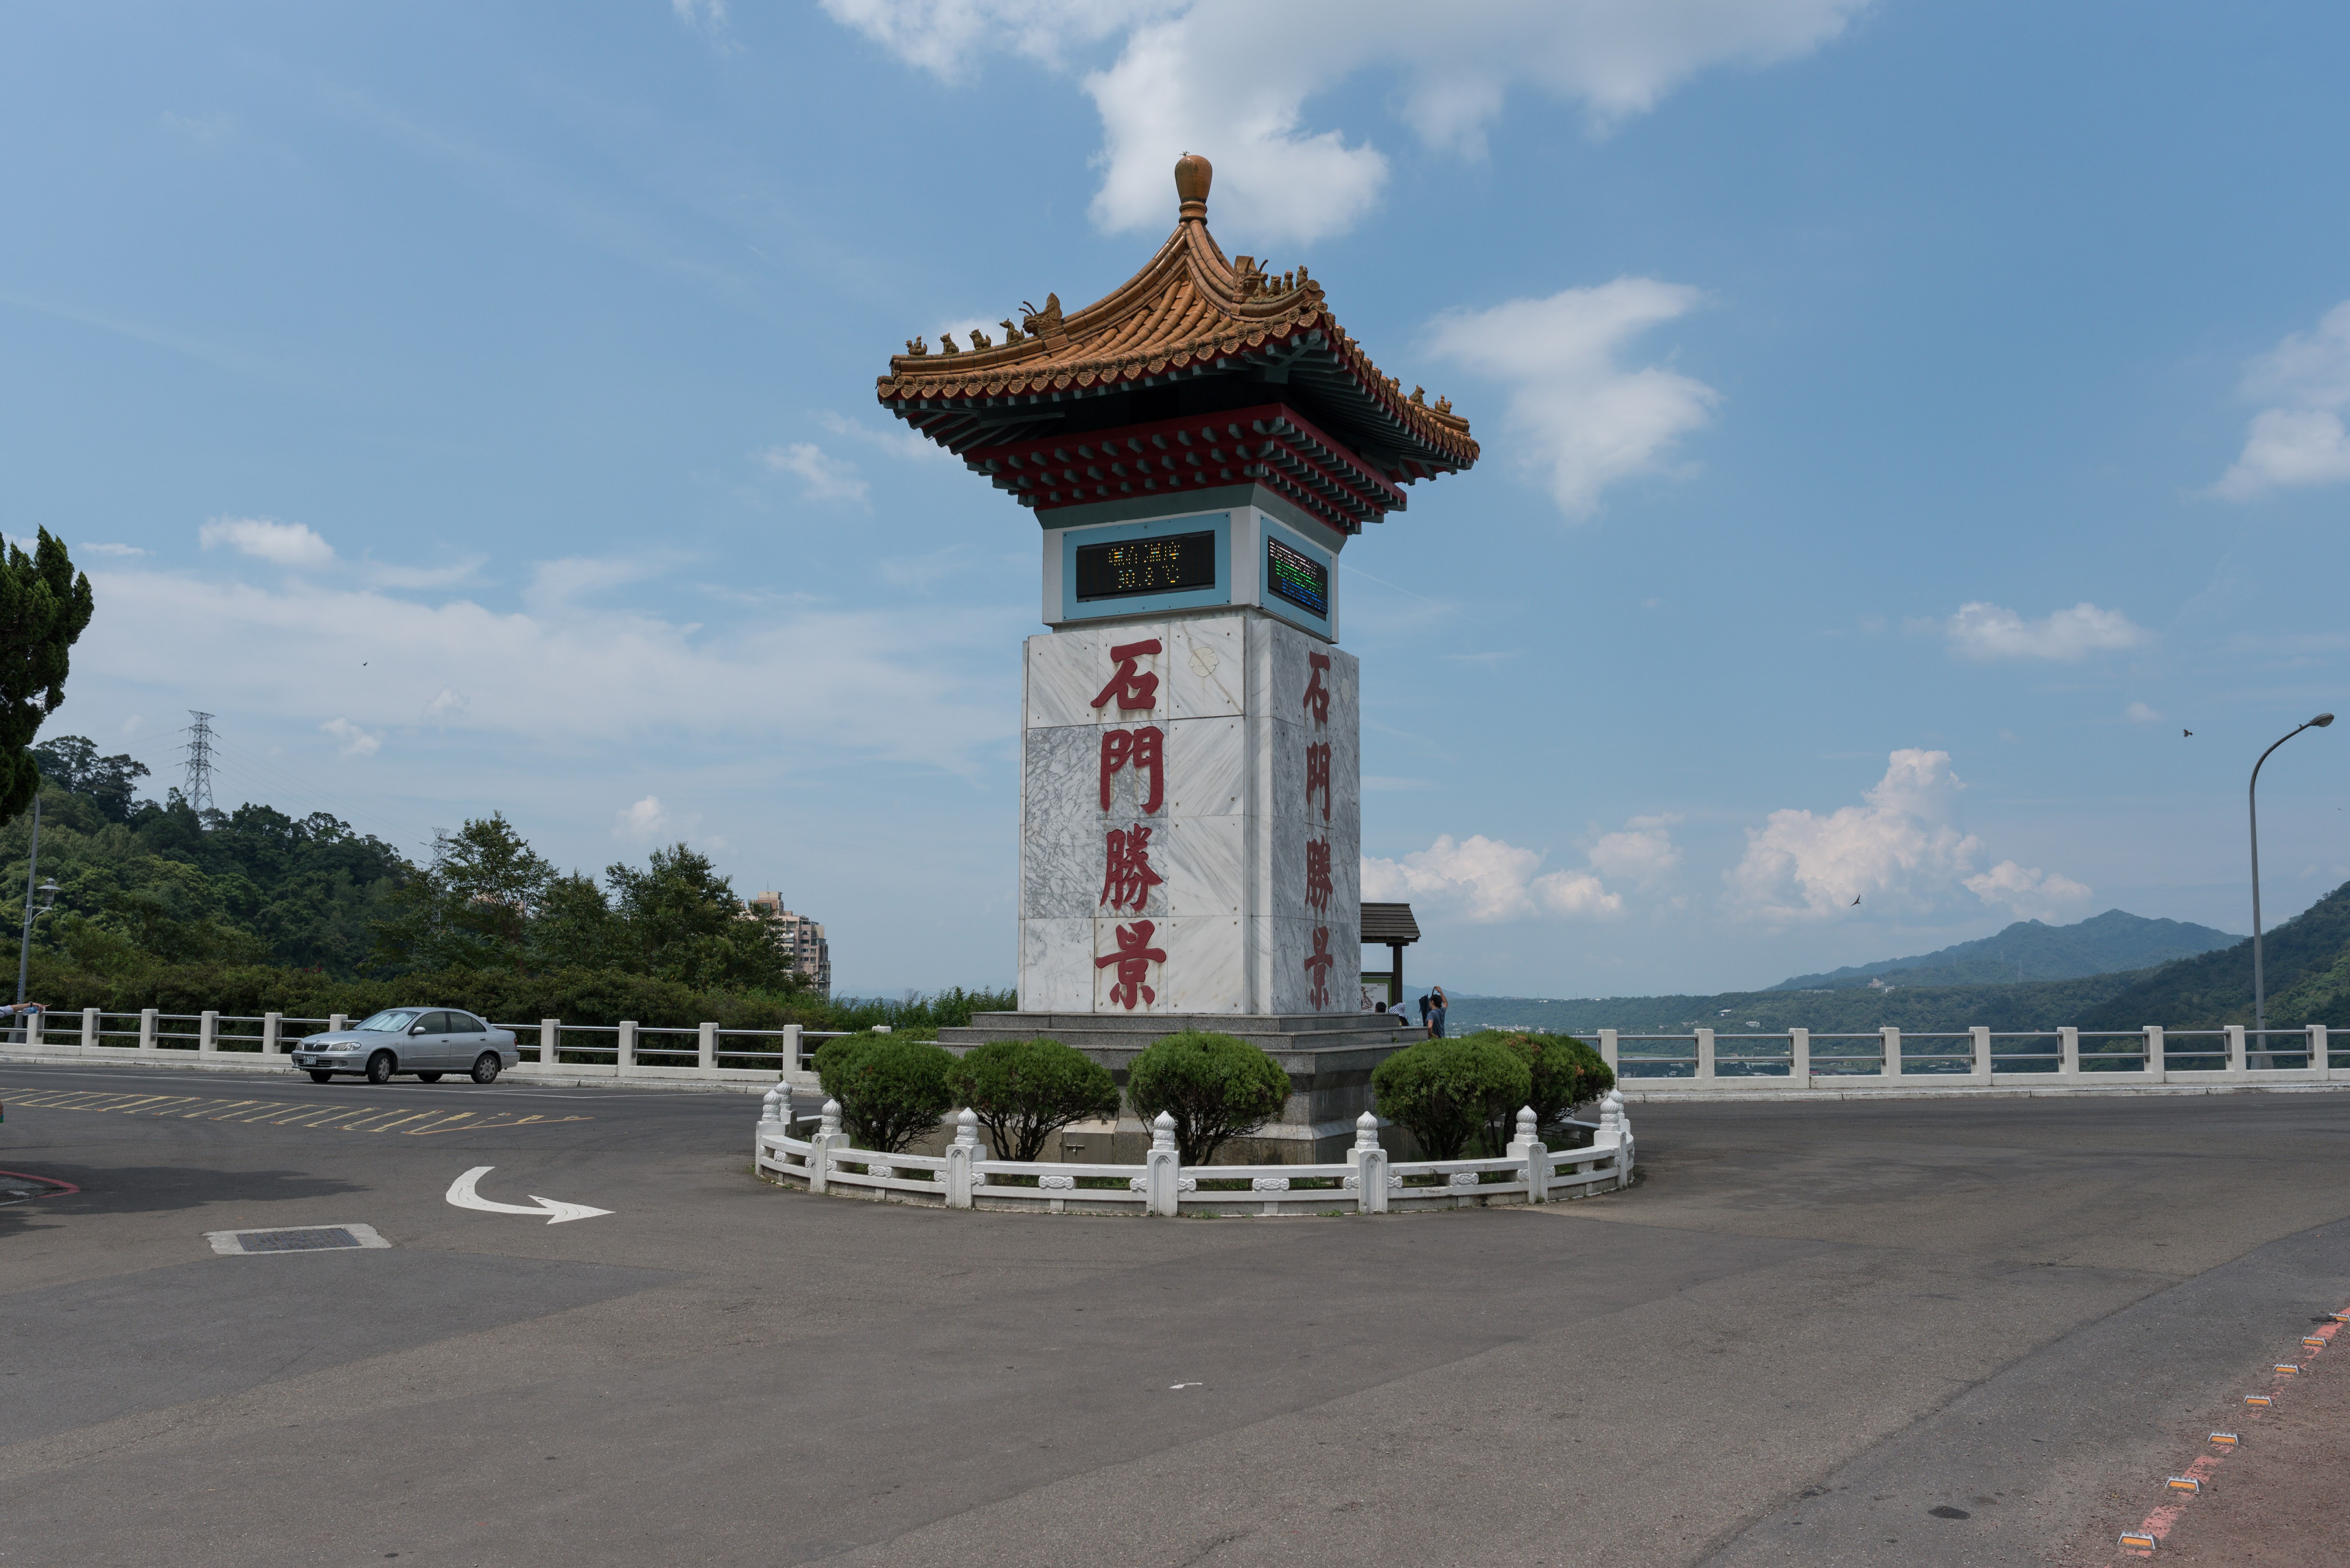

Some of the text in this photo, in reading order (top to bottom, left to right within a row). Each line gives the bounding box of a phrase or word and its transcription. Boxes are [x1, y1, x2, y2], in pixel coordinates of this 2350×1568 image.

[1090, 638, 1167, 1010] 石門勝景
[1303, 651, 1333, 1011] 石門勝景
